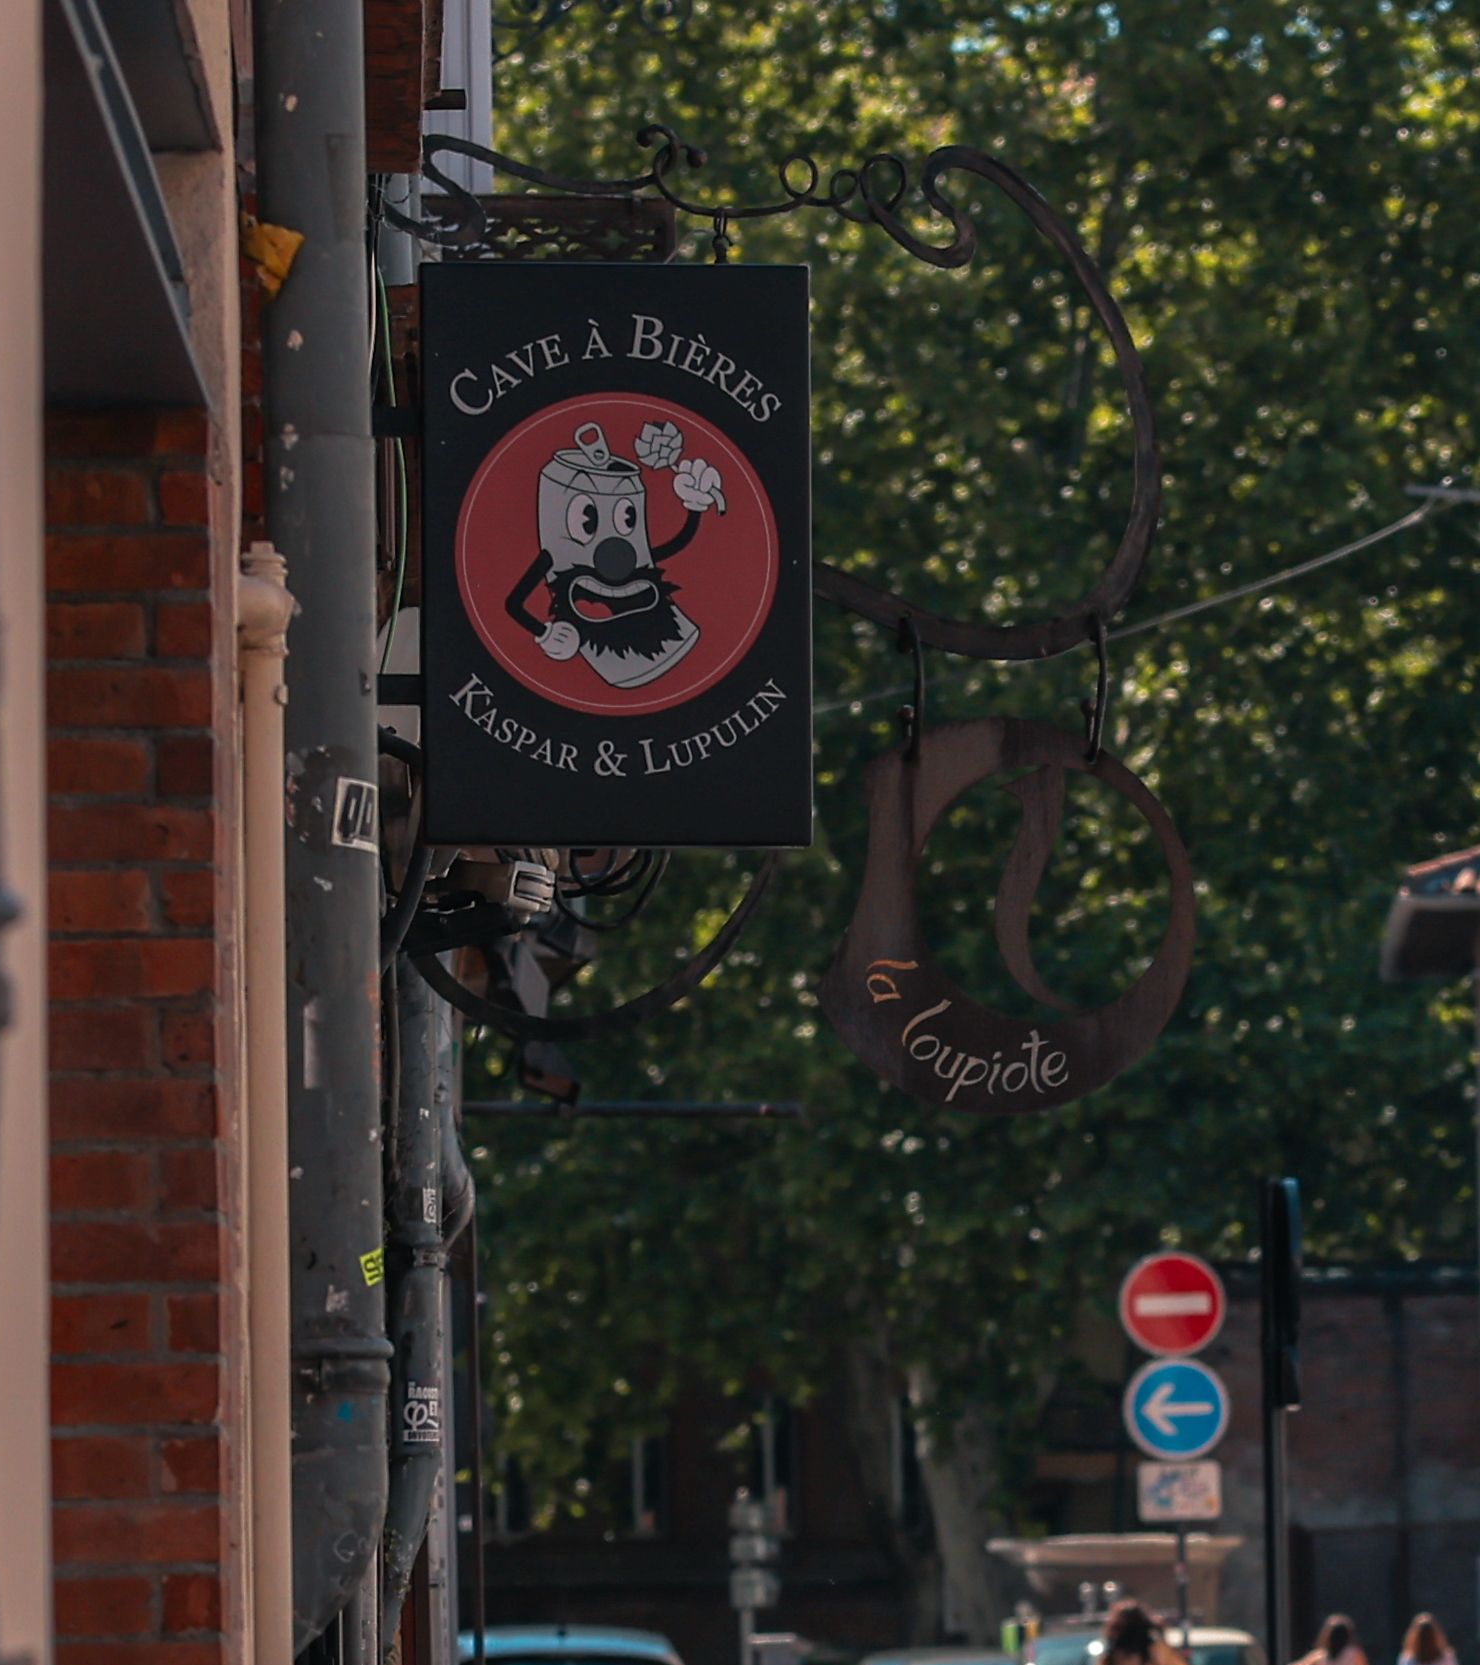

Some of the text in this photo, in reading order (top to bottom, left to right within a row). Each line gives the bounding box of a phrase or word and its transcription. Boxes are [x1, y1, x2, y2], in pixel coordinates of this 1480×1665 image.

[583, 319, 613, 360] À
[449, 673, 788, 777] KASPAR & LUPULIN
